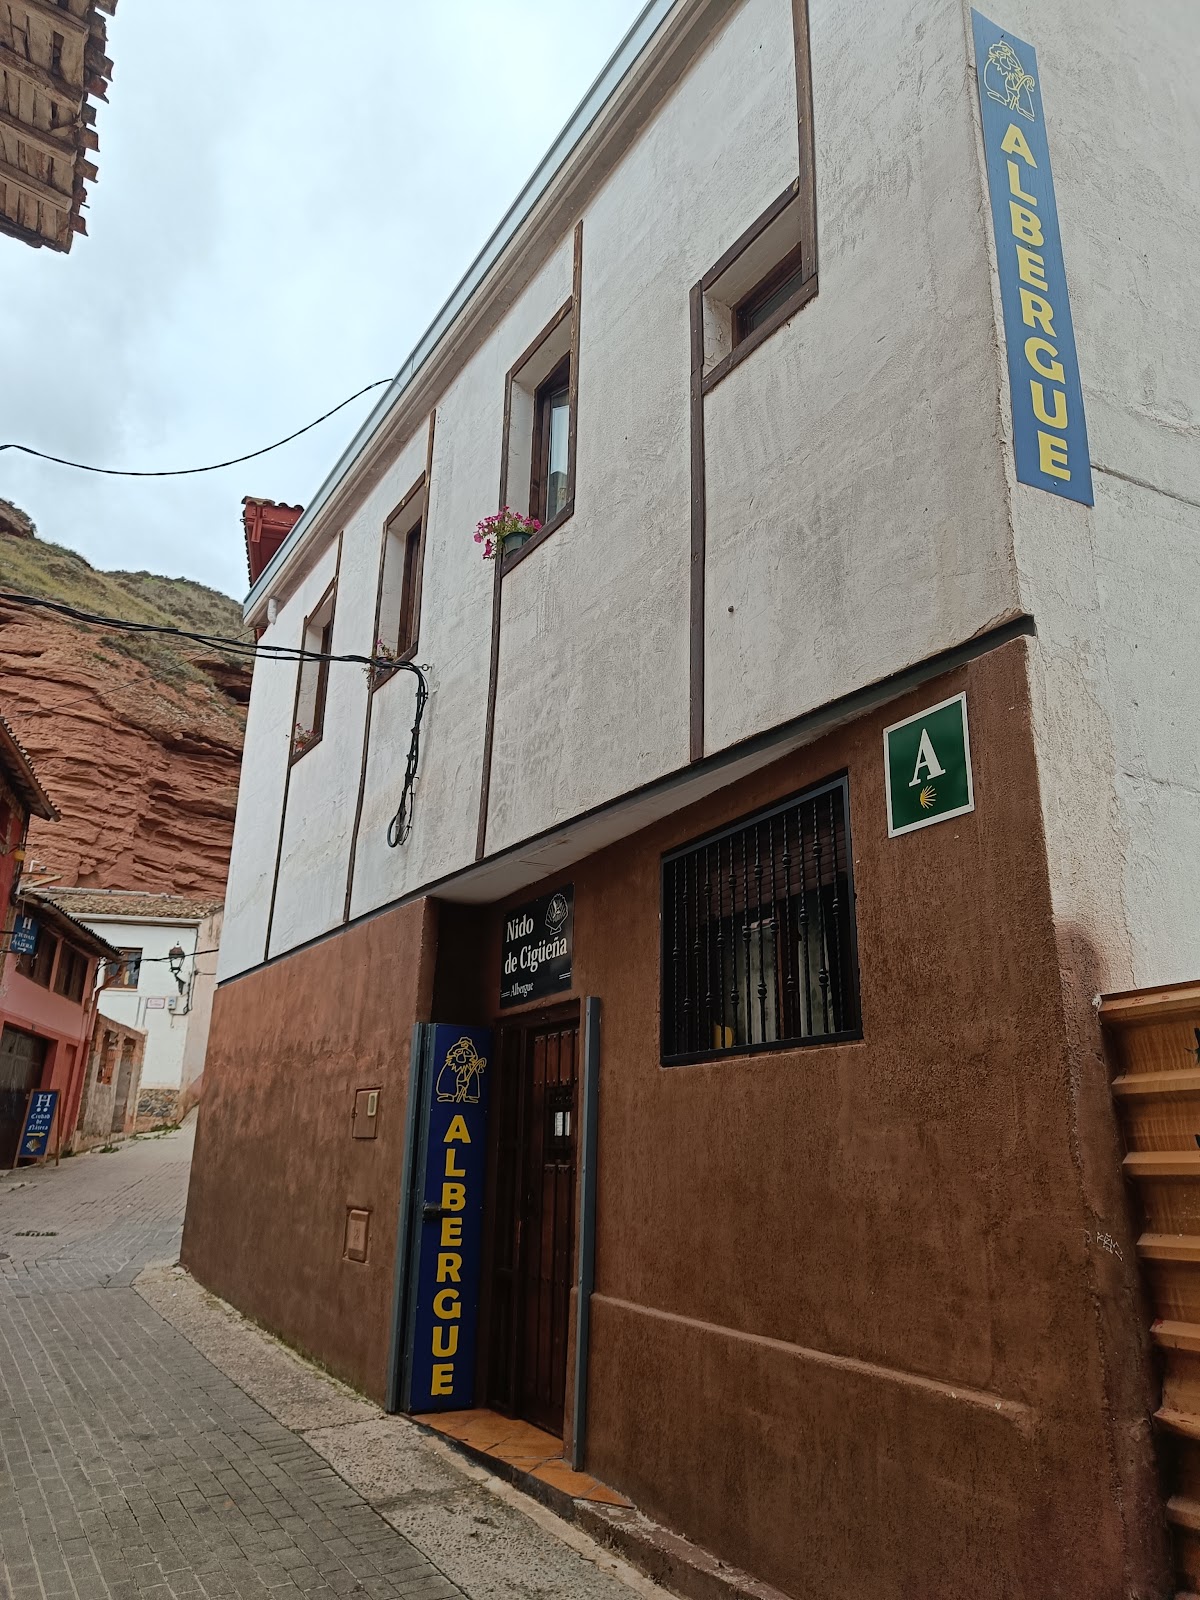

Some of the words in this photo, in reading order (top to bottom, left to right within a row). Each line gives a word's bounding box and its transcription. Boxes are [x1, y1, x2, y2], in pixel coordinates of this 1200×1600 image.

[1000, 122, 1072, 482] ALBERGUE
[908, 727, 946, 788] A
[506, 913, 534, 943] Nido
[505, 952, 518, 975] de
[520, 936, 568, 973] Cigüeña
[510, 982, 534, 998] Albergue
[430, 1114, 471, 1396] ALBERGUE
